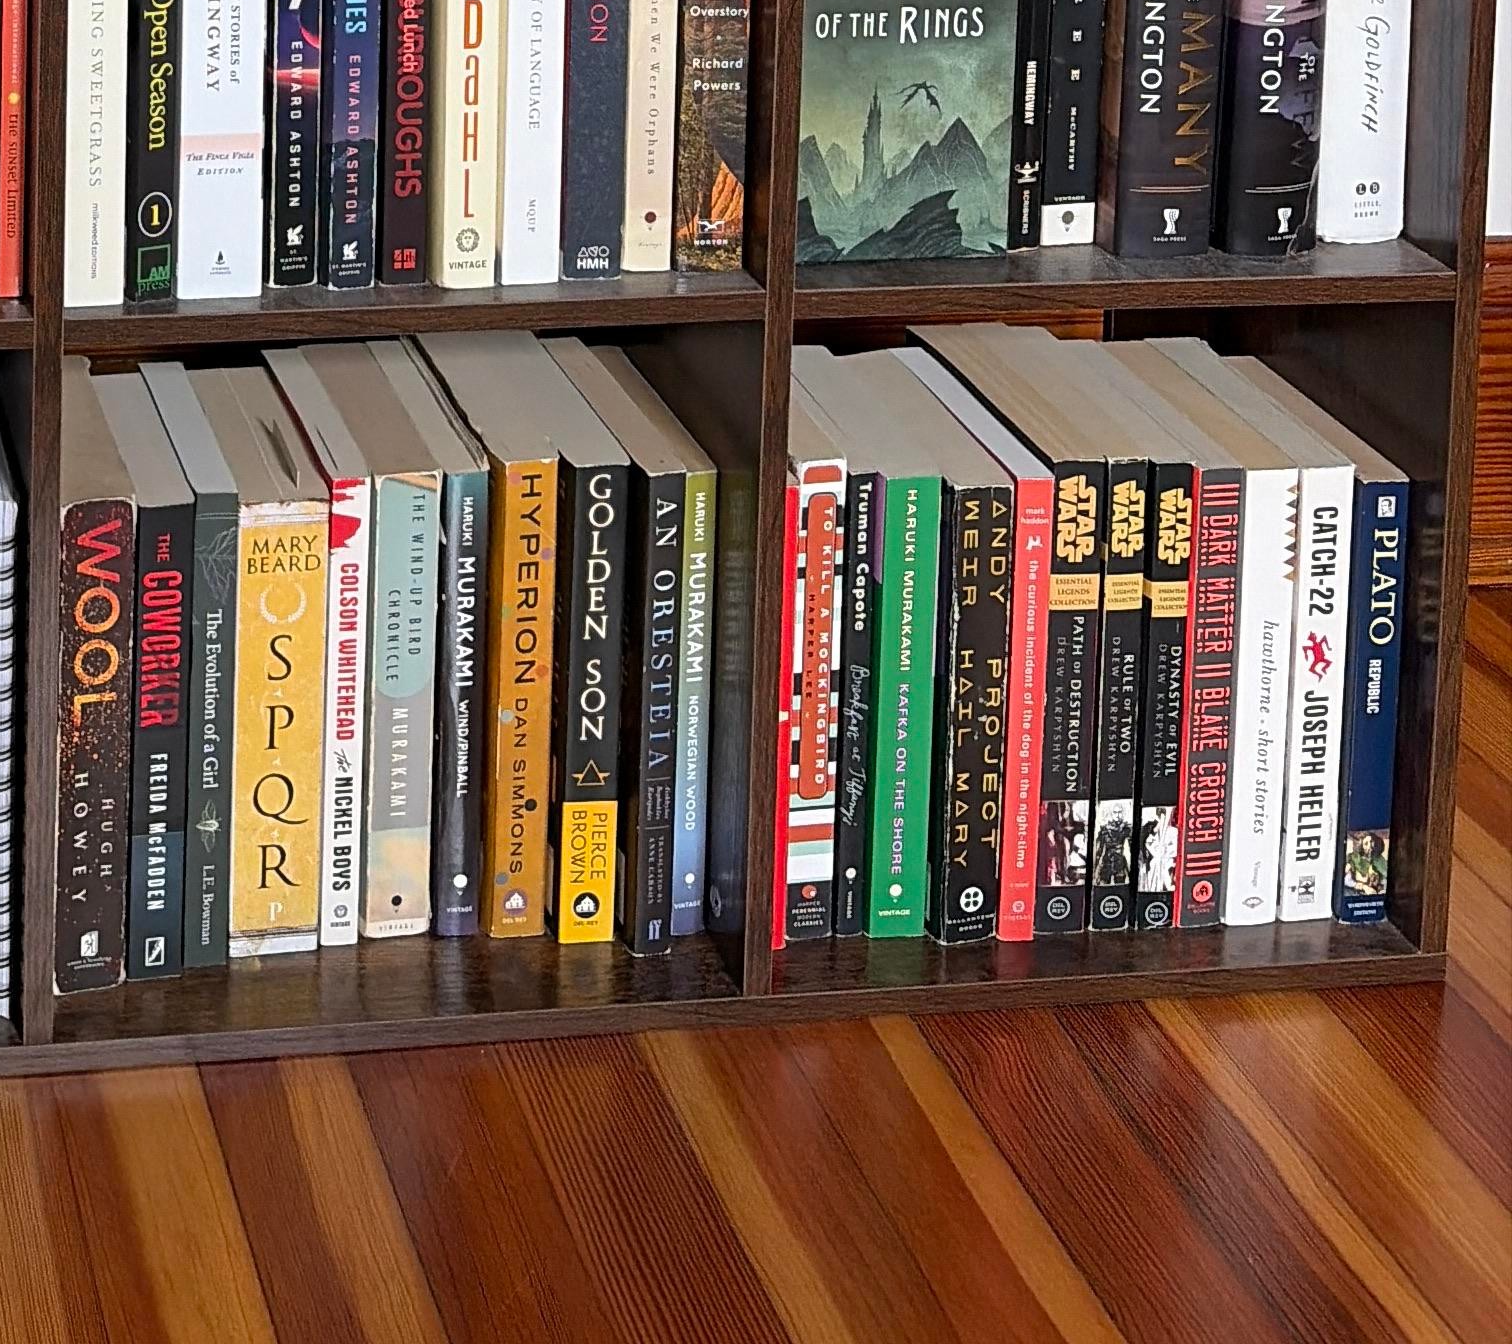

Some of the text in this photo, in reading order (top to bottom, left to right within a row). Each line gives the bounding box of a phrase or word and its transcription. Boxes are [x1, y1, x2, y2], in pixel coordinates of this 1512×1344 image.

[690, 5, 750, 18] Overstory
[815, 6, 985, 44] OF THE RINGS
[692, 57, 744, 70] Richard
[693, 79, 741, 91] Powers
[148, 63, 173, 151] Season
[449, 260, 487, 270] VINTAGE
[247, 554, 322, 574] BEARD
[252, 535, 319, 555] MARY
[74, 518, 122, 727] WOOL
[1367, 527, 1399, 714] PLATO REPUBLIC
[336, 563, 359, 741] COLSON WHITEHEAD
[510, 474, 543, 874] HYPERION DAN SIMMONS
[891, 489, 918, 875] HARUKI MURAKAMI KAFKA ON THE SHORE
[1296, 506, 1338, 862] CATCH-22 JOSEPH HELLER
[149, 753, 168, 814] FREIDA
